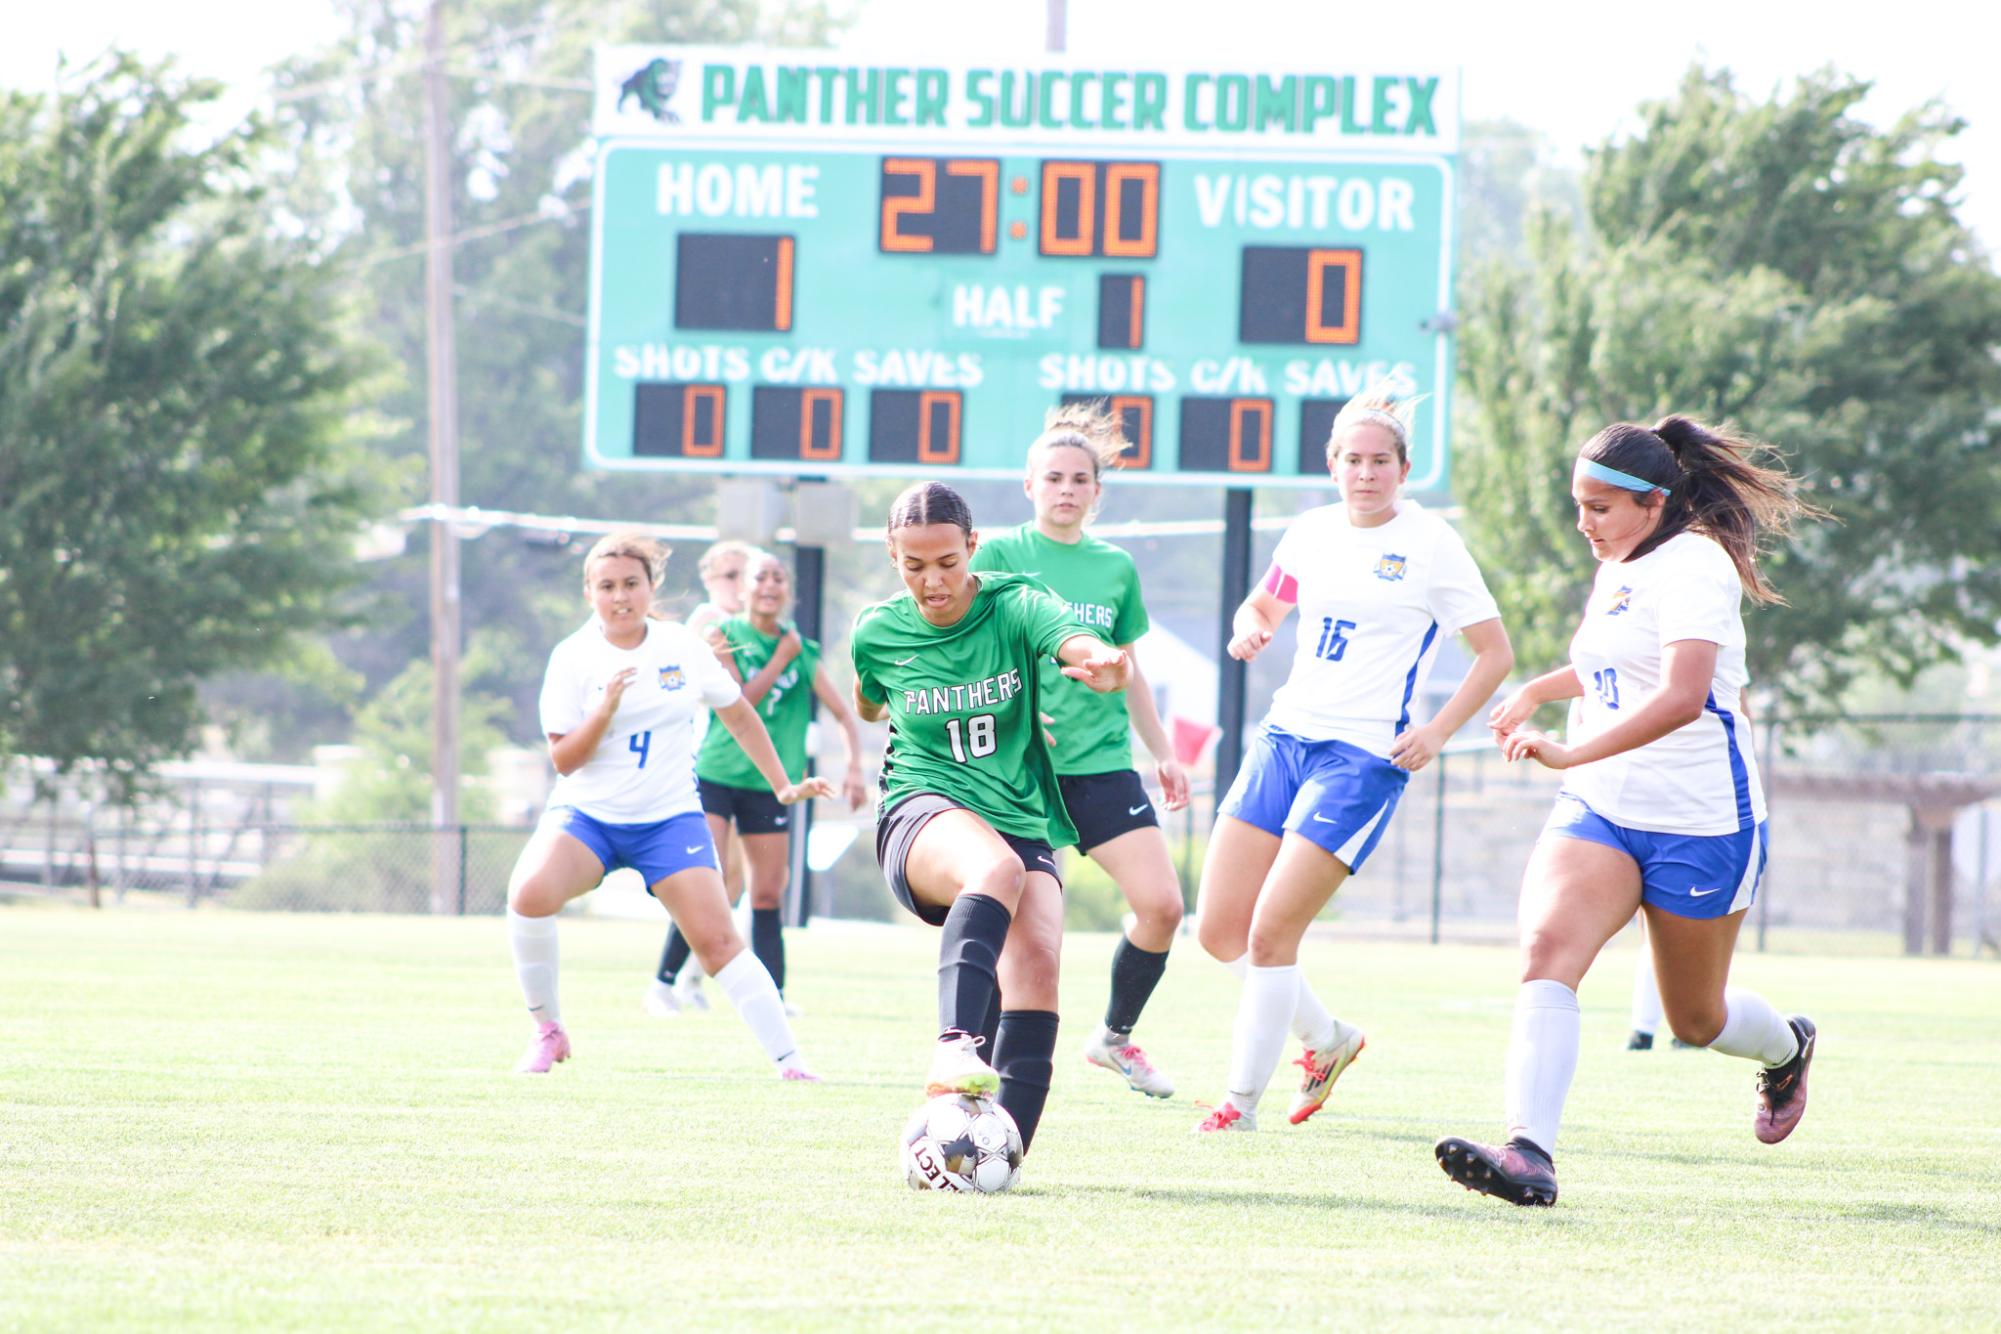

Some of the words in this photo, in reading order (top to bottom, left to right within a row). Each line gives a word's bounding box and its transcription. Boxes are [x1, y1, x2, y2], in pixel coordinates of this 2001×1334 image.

[702, 64, 950, 127] PANTHER
[1183, 71, 1439, 136] COMPLEX
[656, 162, 820, 218] HOME
[881, 158, 1160, 257] 27:00
[1194, 174, 1415, 231] VISITOR
[775, 236, 794, 331] 1
[953, 284, 1066, 329] HALF
[1130, 275, 1145, 349] 1
[1305, 248, 1362, 344] 0
[613, 342, 750, 381] SHOTS
[759, 347, 838, 384] C/K
[853, 348, 983, 388] SAVES
[1038, 353, 1176, 393] SHOTS
[682, 384, 726, 458] 0
[800, 387, 844, 461] 0
[918, 390, 962, 464] 0
[1112, 395, 1152, 469] 0
[1228, 397, 1275, 472] 0
[1066, 601, 1113, 629] HERS
[1315, 616, 1357, 662] 16
[904, 668, 1024, 716] PANTHERS
[628, 730, 652, 769] 4
[945, 713, 998, 764] 18
